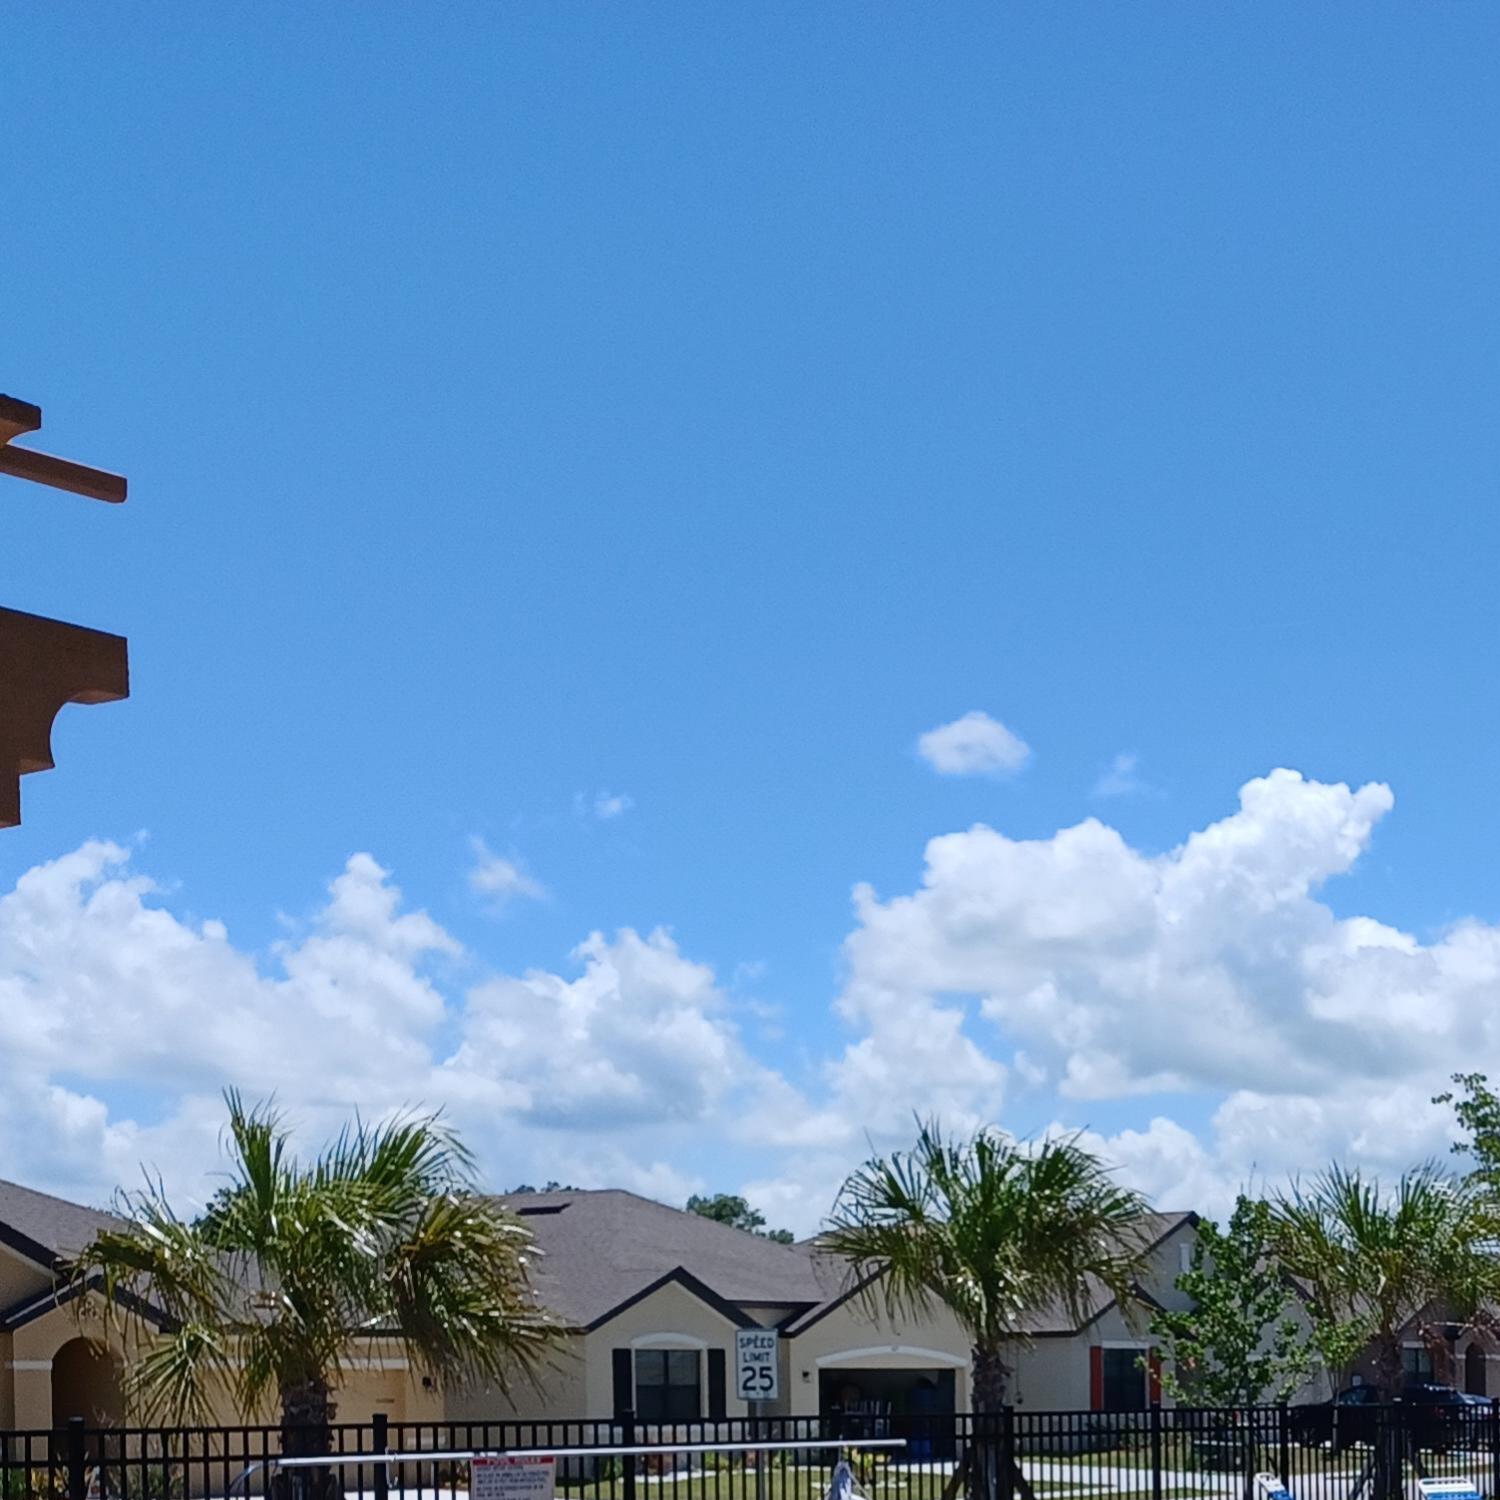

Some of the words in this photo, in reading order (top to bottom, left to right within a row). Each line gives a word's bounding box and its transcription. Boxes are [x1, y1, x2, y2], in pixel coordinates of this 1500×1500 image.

[739, 1335, 774, 1349] SPEED
[743, 1351, 770, 1363] LIMIT
[742, 1366, 774, 1391] 25
